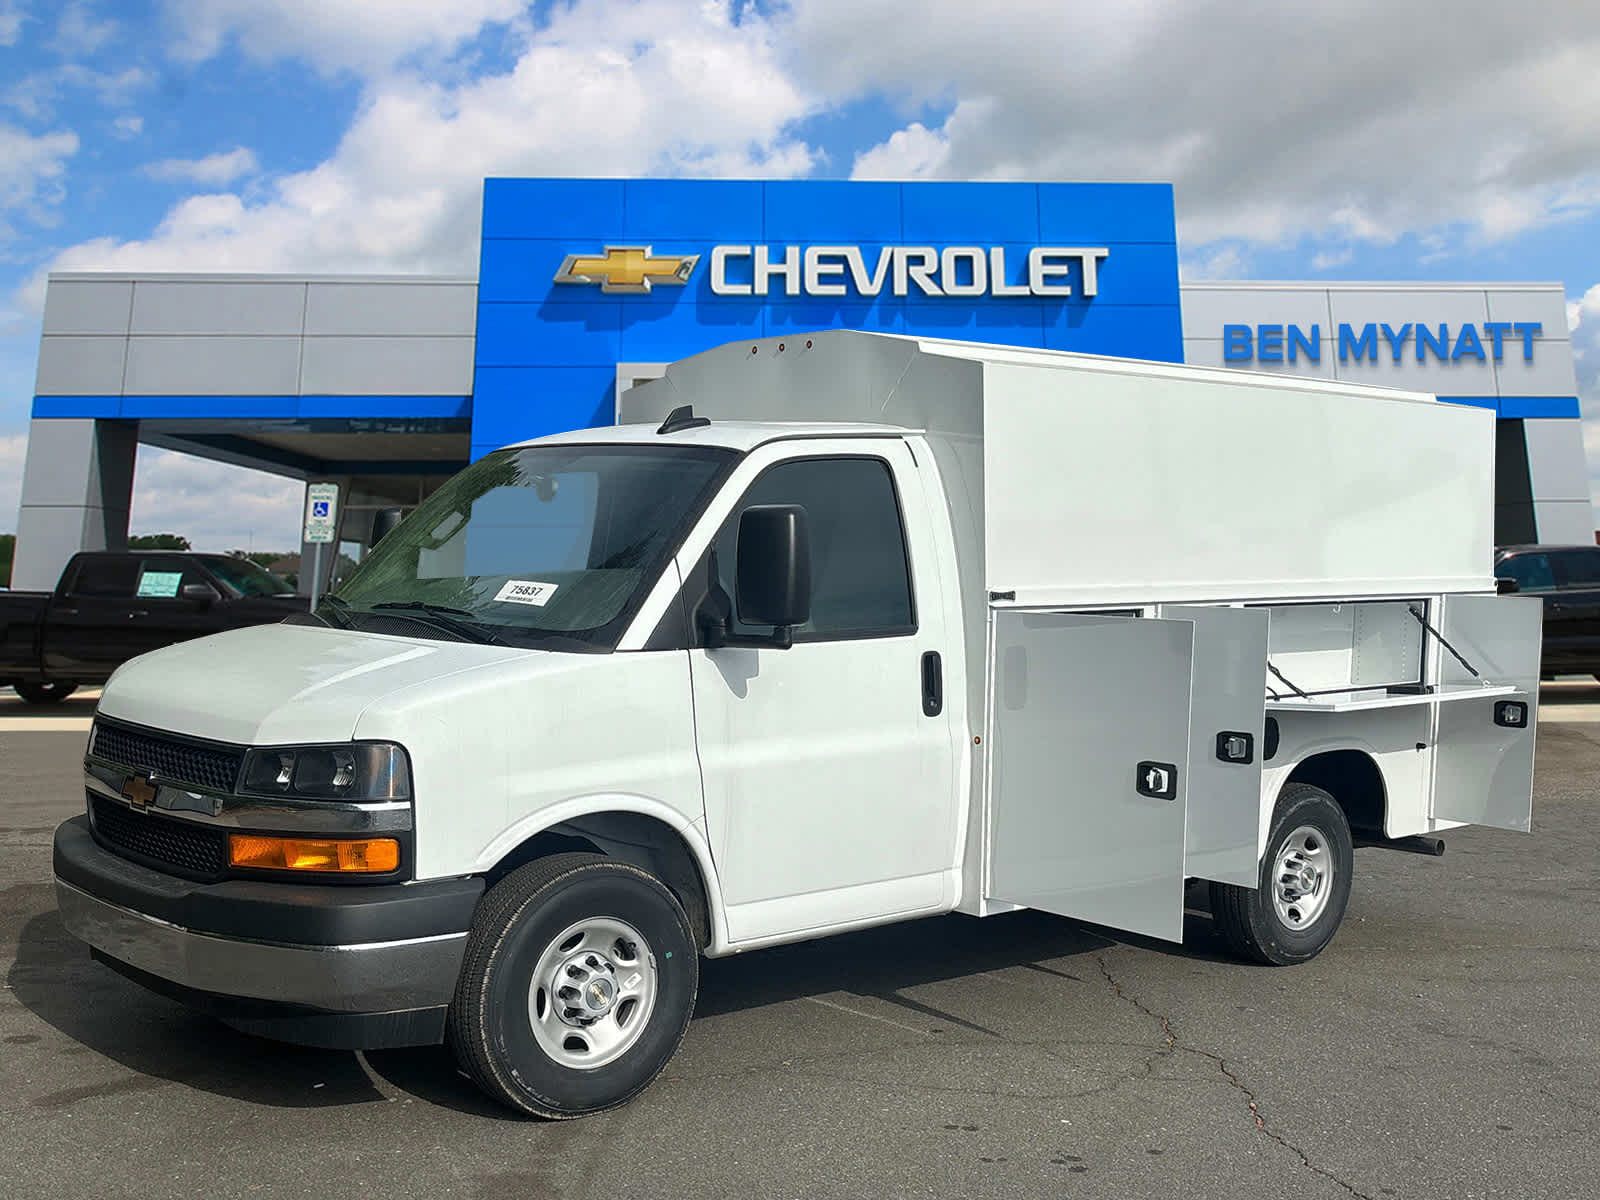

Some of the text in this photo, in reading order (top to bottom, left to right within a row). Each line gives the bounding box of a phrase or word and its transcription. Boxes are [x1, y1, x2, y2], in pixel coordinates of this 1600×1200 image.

[710, 245, 1109, 297] CHEVROLET
[1224, 322, 1543, 362] BEN MYNATT
[510, 585, 543, 597] 75837
